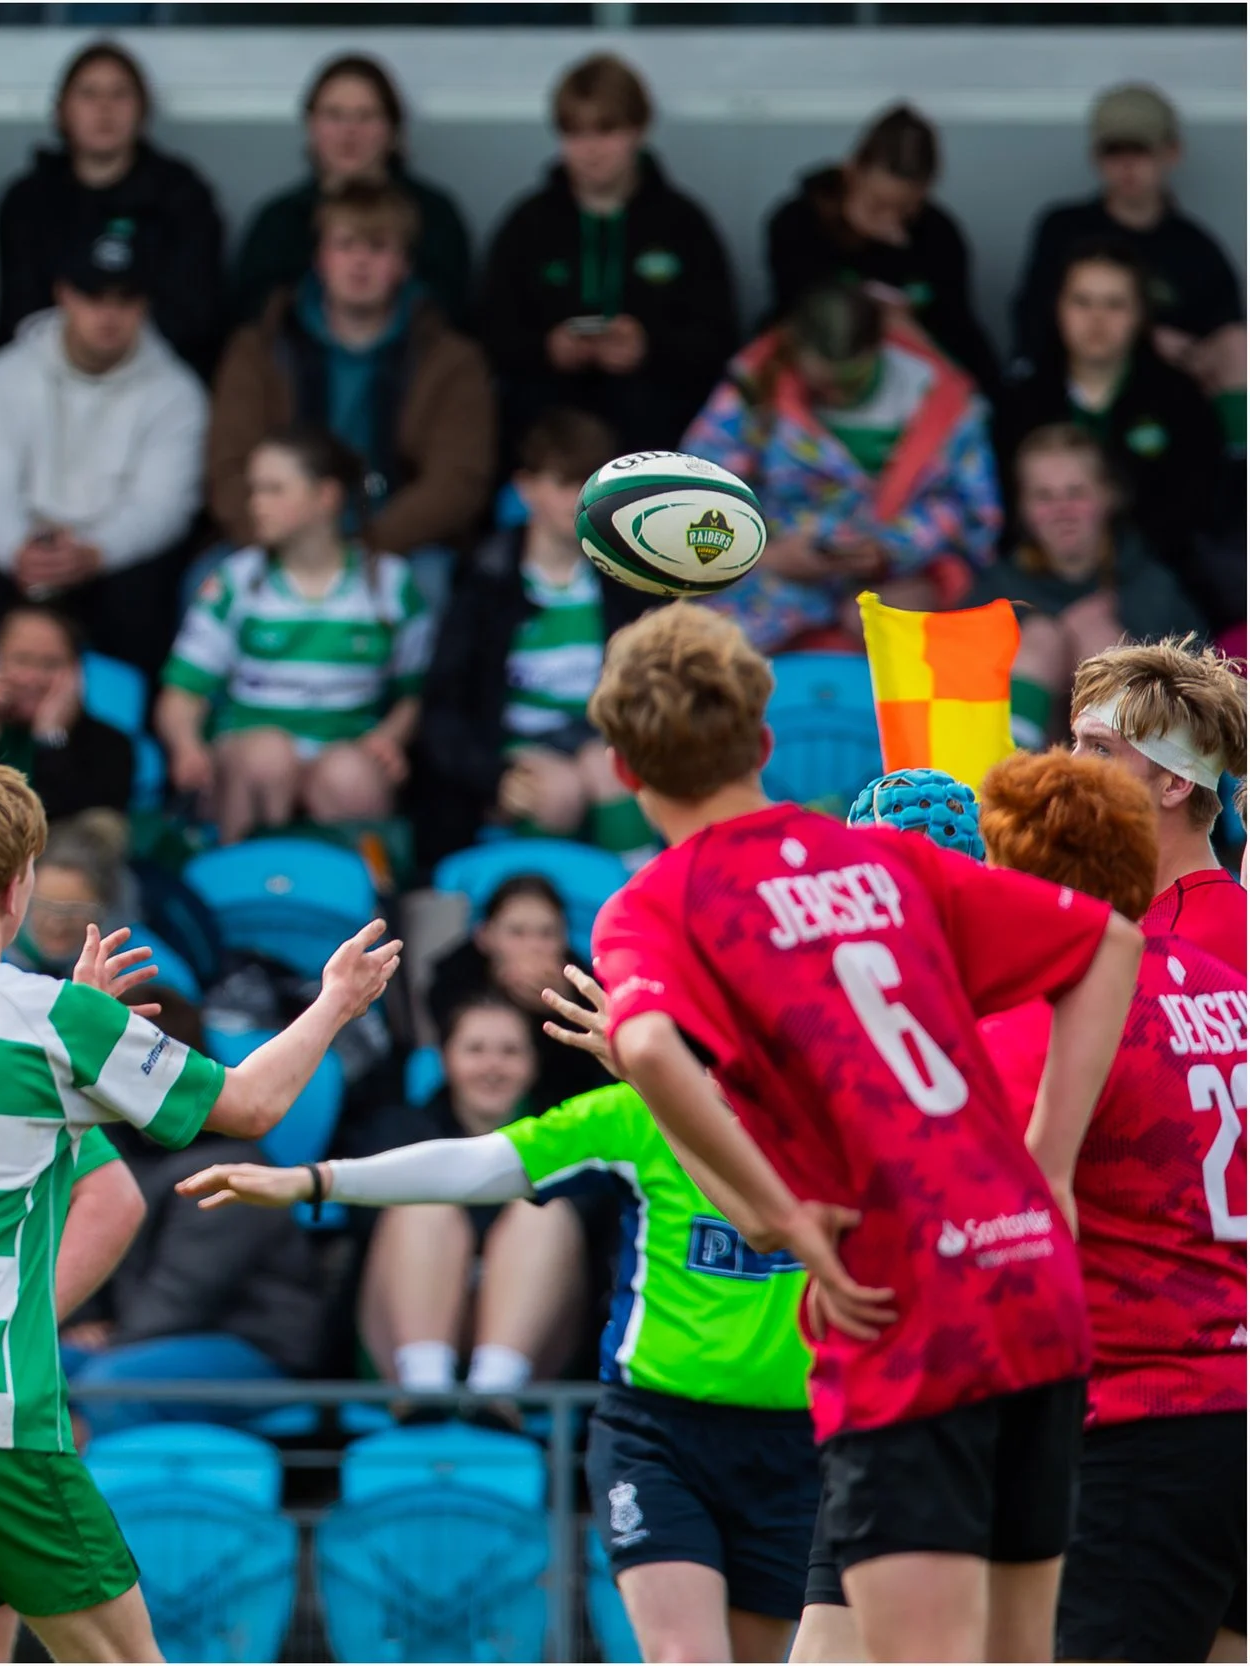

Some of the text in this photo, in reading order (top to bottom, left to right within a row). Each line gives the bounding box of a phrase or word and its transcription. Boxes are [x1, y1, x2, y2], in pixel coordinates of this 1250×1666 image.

[688, 530, 732, 550] RAIDERS
[756, 863, 905, 950] JERSEY
[833, 940, 969, 1117] 6
